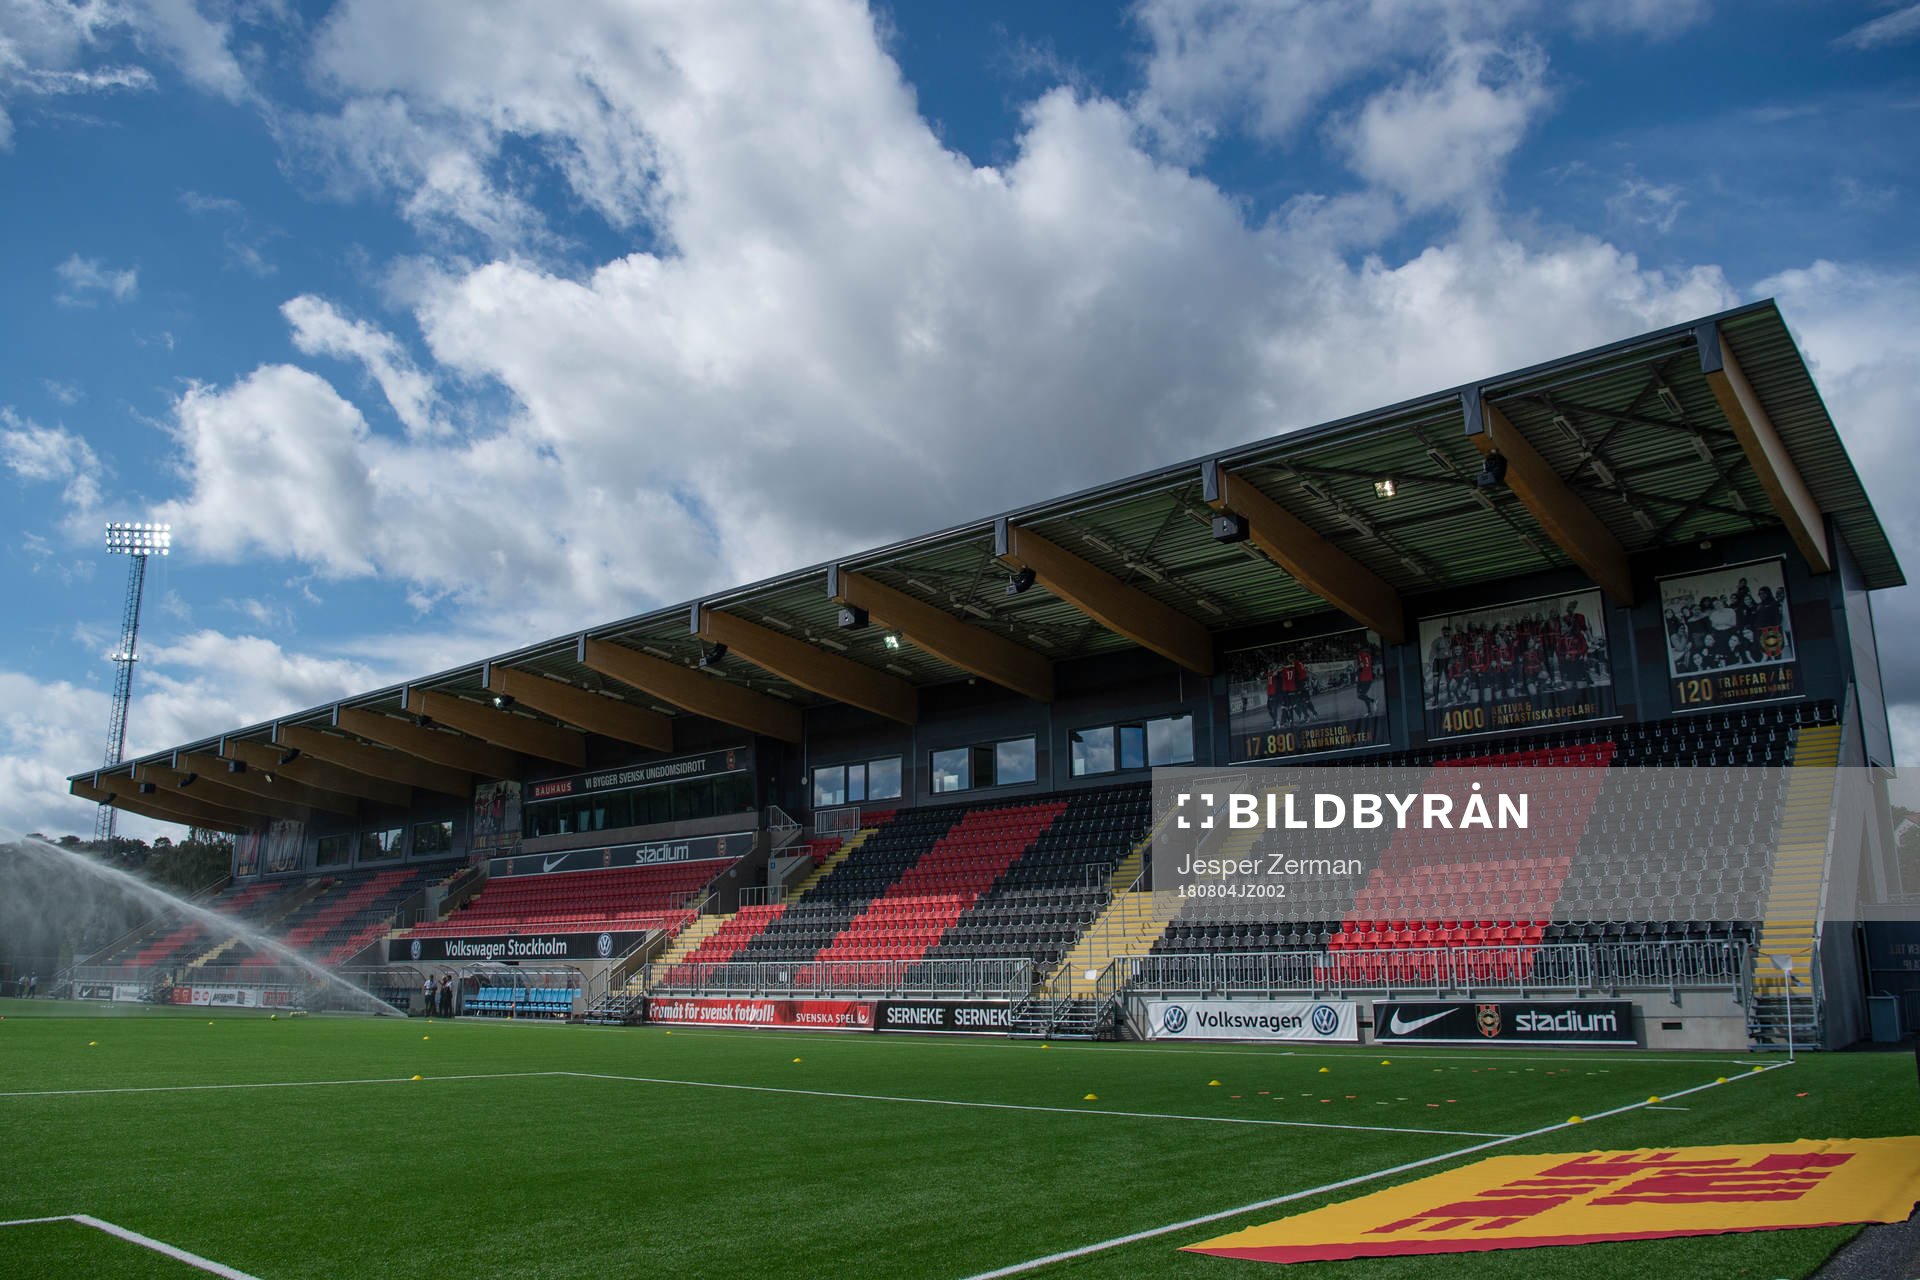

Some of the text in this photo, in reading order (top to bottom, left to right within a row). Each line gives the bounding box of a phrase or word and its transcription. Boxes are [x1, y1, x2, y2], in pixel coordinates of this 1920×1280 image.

[1678, 678, 1713, 704] 120
[1443, 707, 1485, 733] 4000
[1493, 709, 1554, 725] FANTASTISKA
[1301, 725, 1348, 740] SPORTSLIGA
[1247, 733, 1295, 757] 17.890
[586, 759, 707, 789] VI BYGGER SVENSK UNGDOMSIDROTT
[535, 781, 573, 797] BAUHAUS
[635, 842, 689, 863] stadium
[445, 938, 568, 959] Volkswagen Stockholm
[649, 1002, 684, 1020] Framåt
[684, 1003, 700, 1020] för
[700, 1004, 735, 1021] svensk
[797, 1013, 858, 1024] SVENSKA SPEL
[887, 1007, 944, 1025] SERNEKE
[1196, 1011, 1302, 1032] Volkswagen
[1516, 1010, 1617, 1032] stadium
